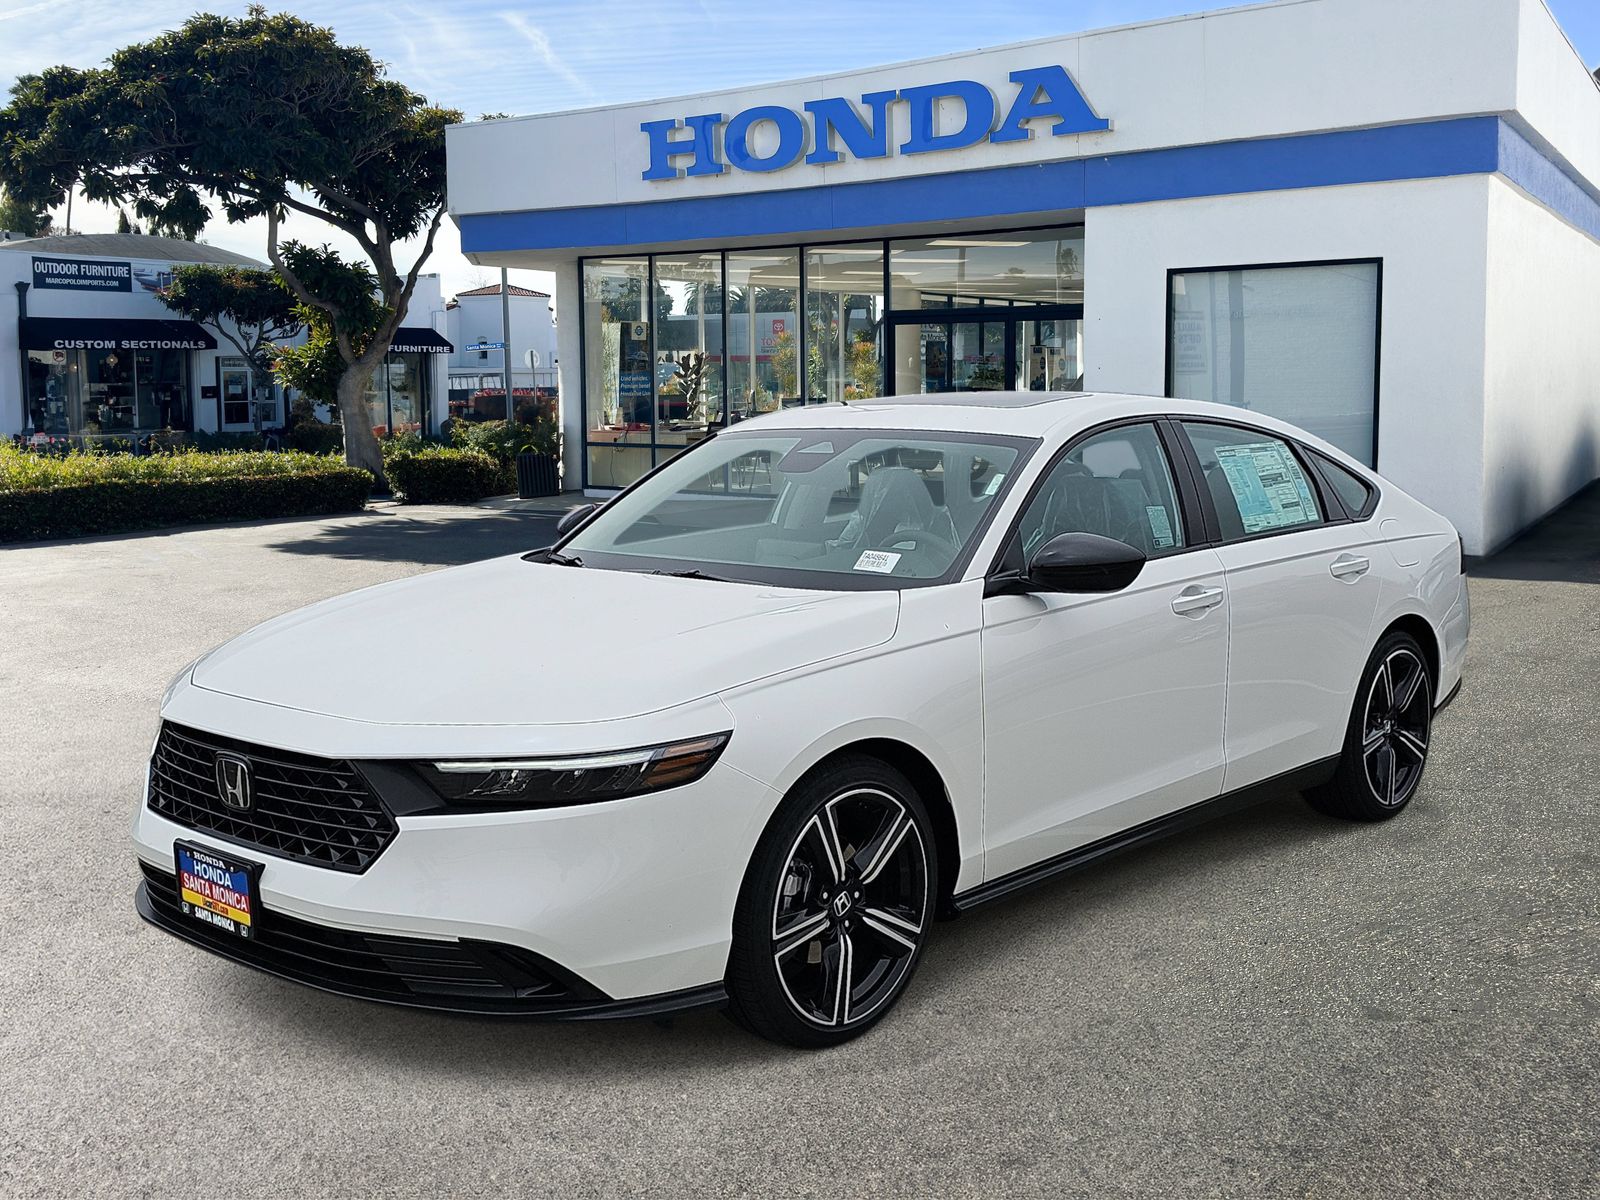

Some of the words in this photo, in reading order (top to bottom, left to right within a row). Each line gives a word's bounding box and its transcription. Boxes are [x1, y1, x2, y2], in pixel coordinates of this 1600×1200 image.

[640, 64, 1112, 183] HONDA
[34, 260, 78, 276] OUTDOOR
[80, 264, 130, 278] FURNITURE
[45, 277, 119, 287] MARCOPOLOIMPORTS.COM
[54, 339, 116, 349] CUSTOM
[121, 339, 206, 349] SECTIONALS
[388, 344, 451, 354] FURNITURE
[193, 851, 226, 869] HONDA
[193, 860, 233, 889] HONDA
[183, 873, 211, 898] SANTA
[211, 883, 248, 912] MONICA
[194, 906, 212, 923] SANTA
[212, 913, 235, 933] MONICA
